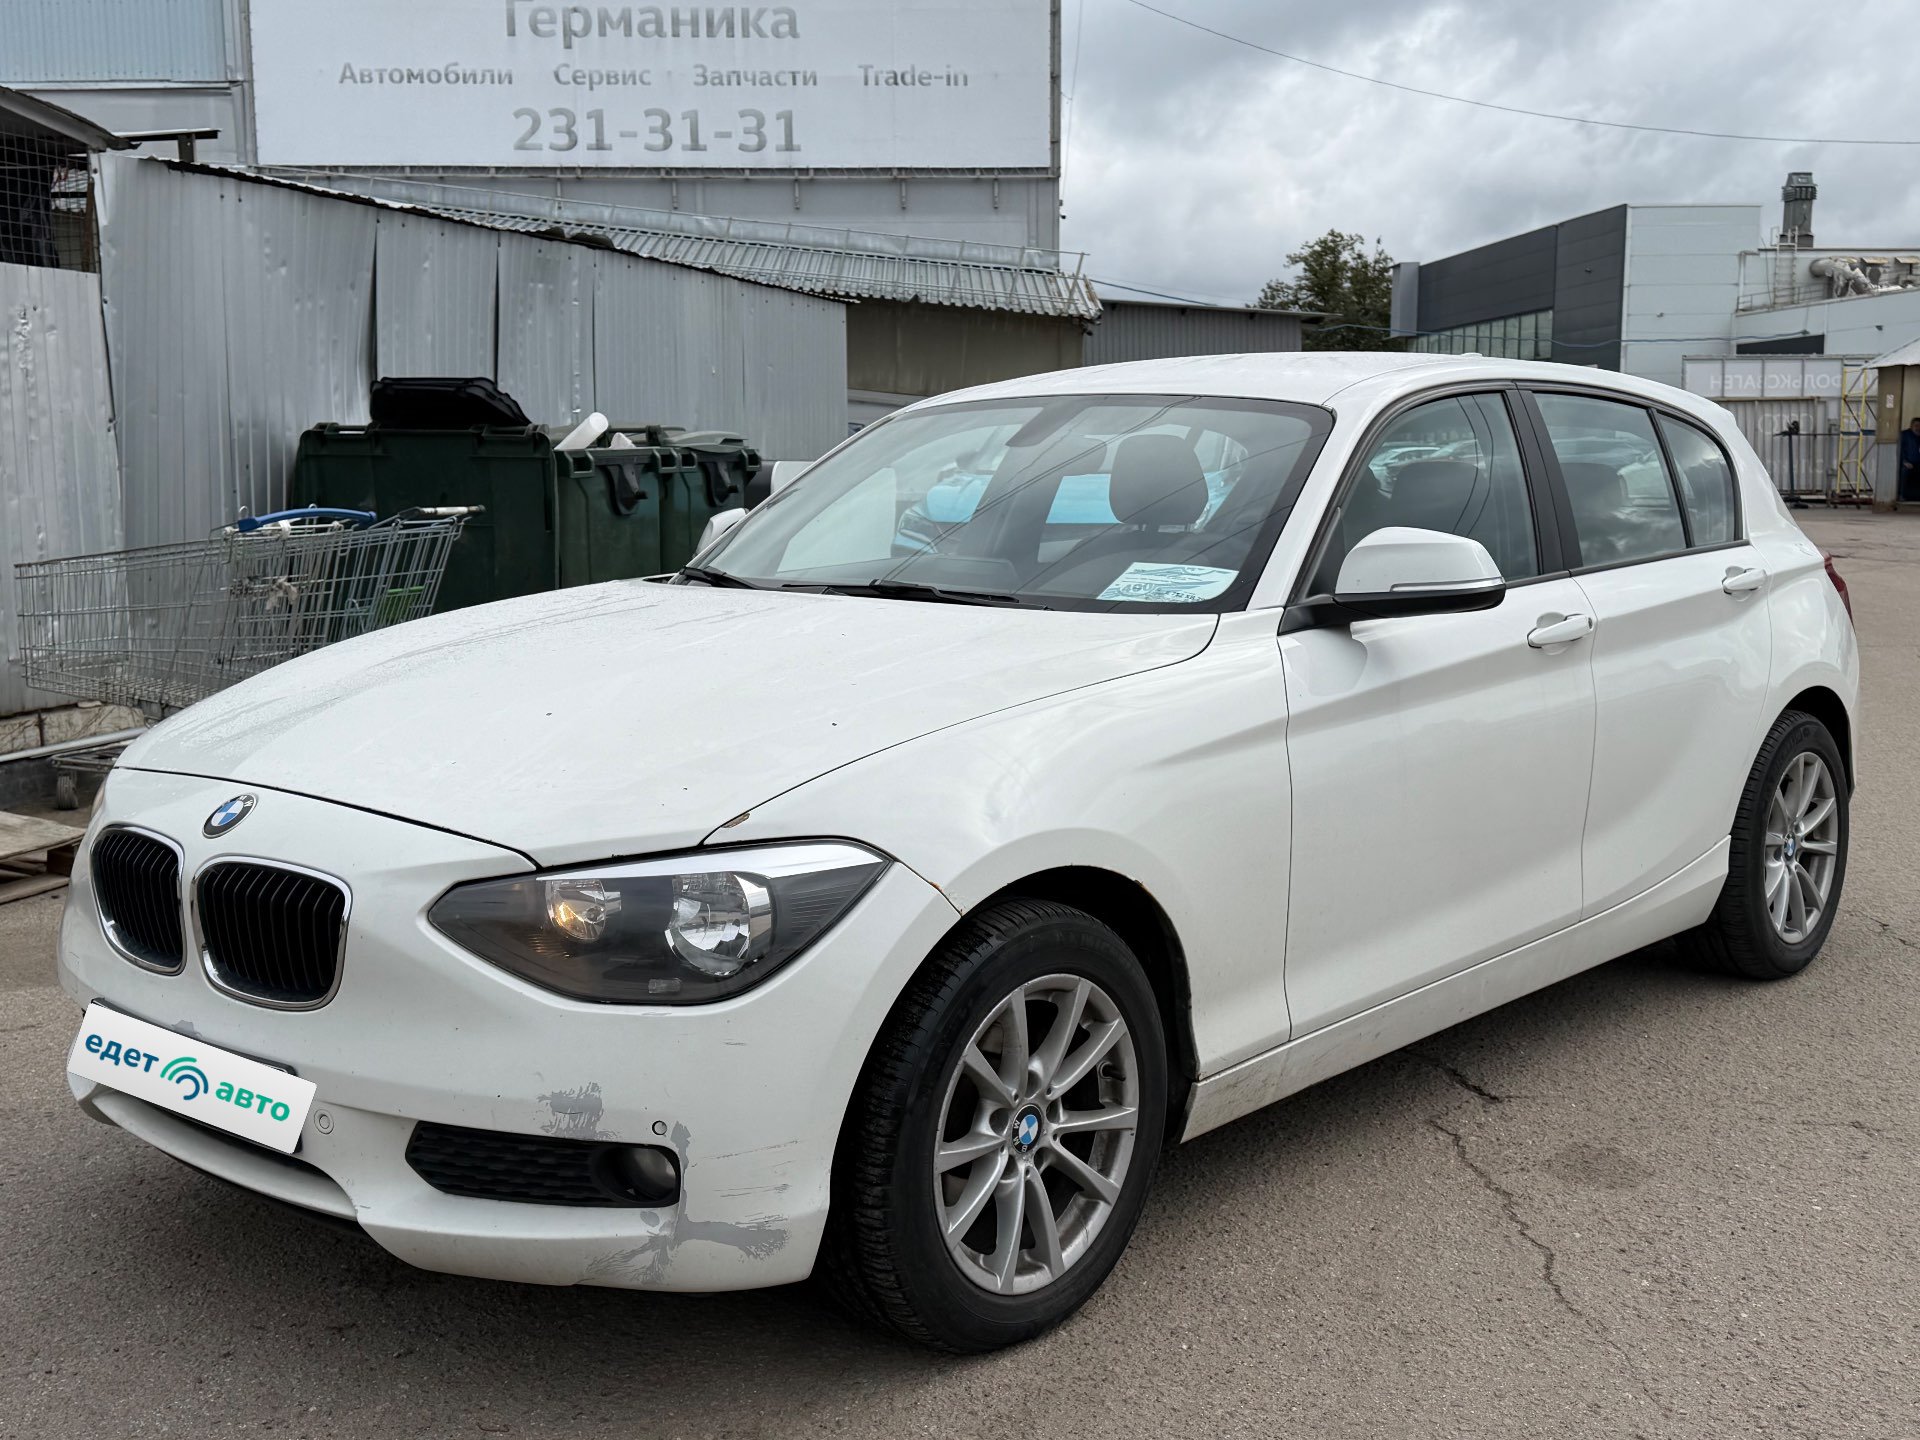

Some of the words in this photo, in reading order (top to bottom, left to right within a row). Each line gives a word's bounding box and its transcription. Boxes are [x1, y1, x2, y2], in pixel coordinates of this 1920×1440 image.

[505, 0, 800, 49] Германика
[338, 62, 513, 85] Автомобили
[553, 63, 651, 91] Сервис
[693, 64, 817, 86] Запчасти
[858, 65, 968, 86] Trade-in
[511, 107, 802, 152] 231-31-31
